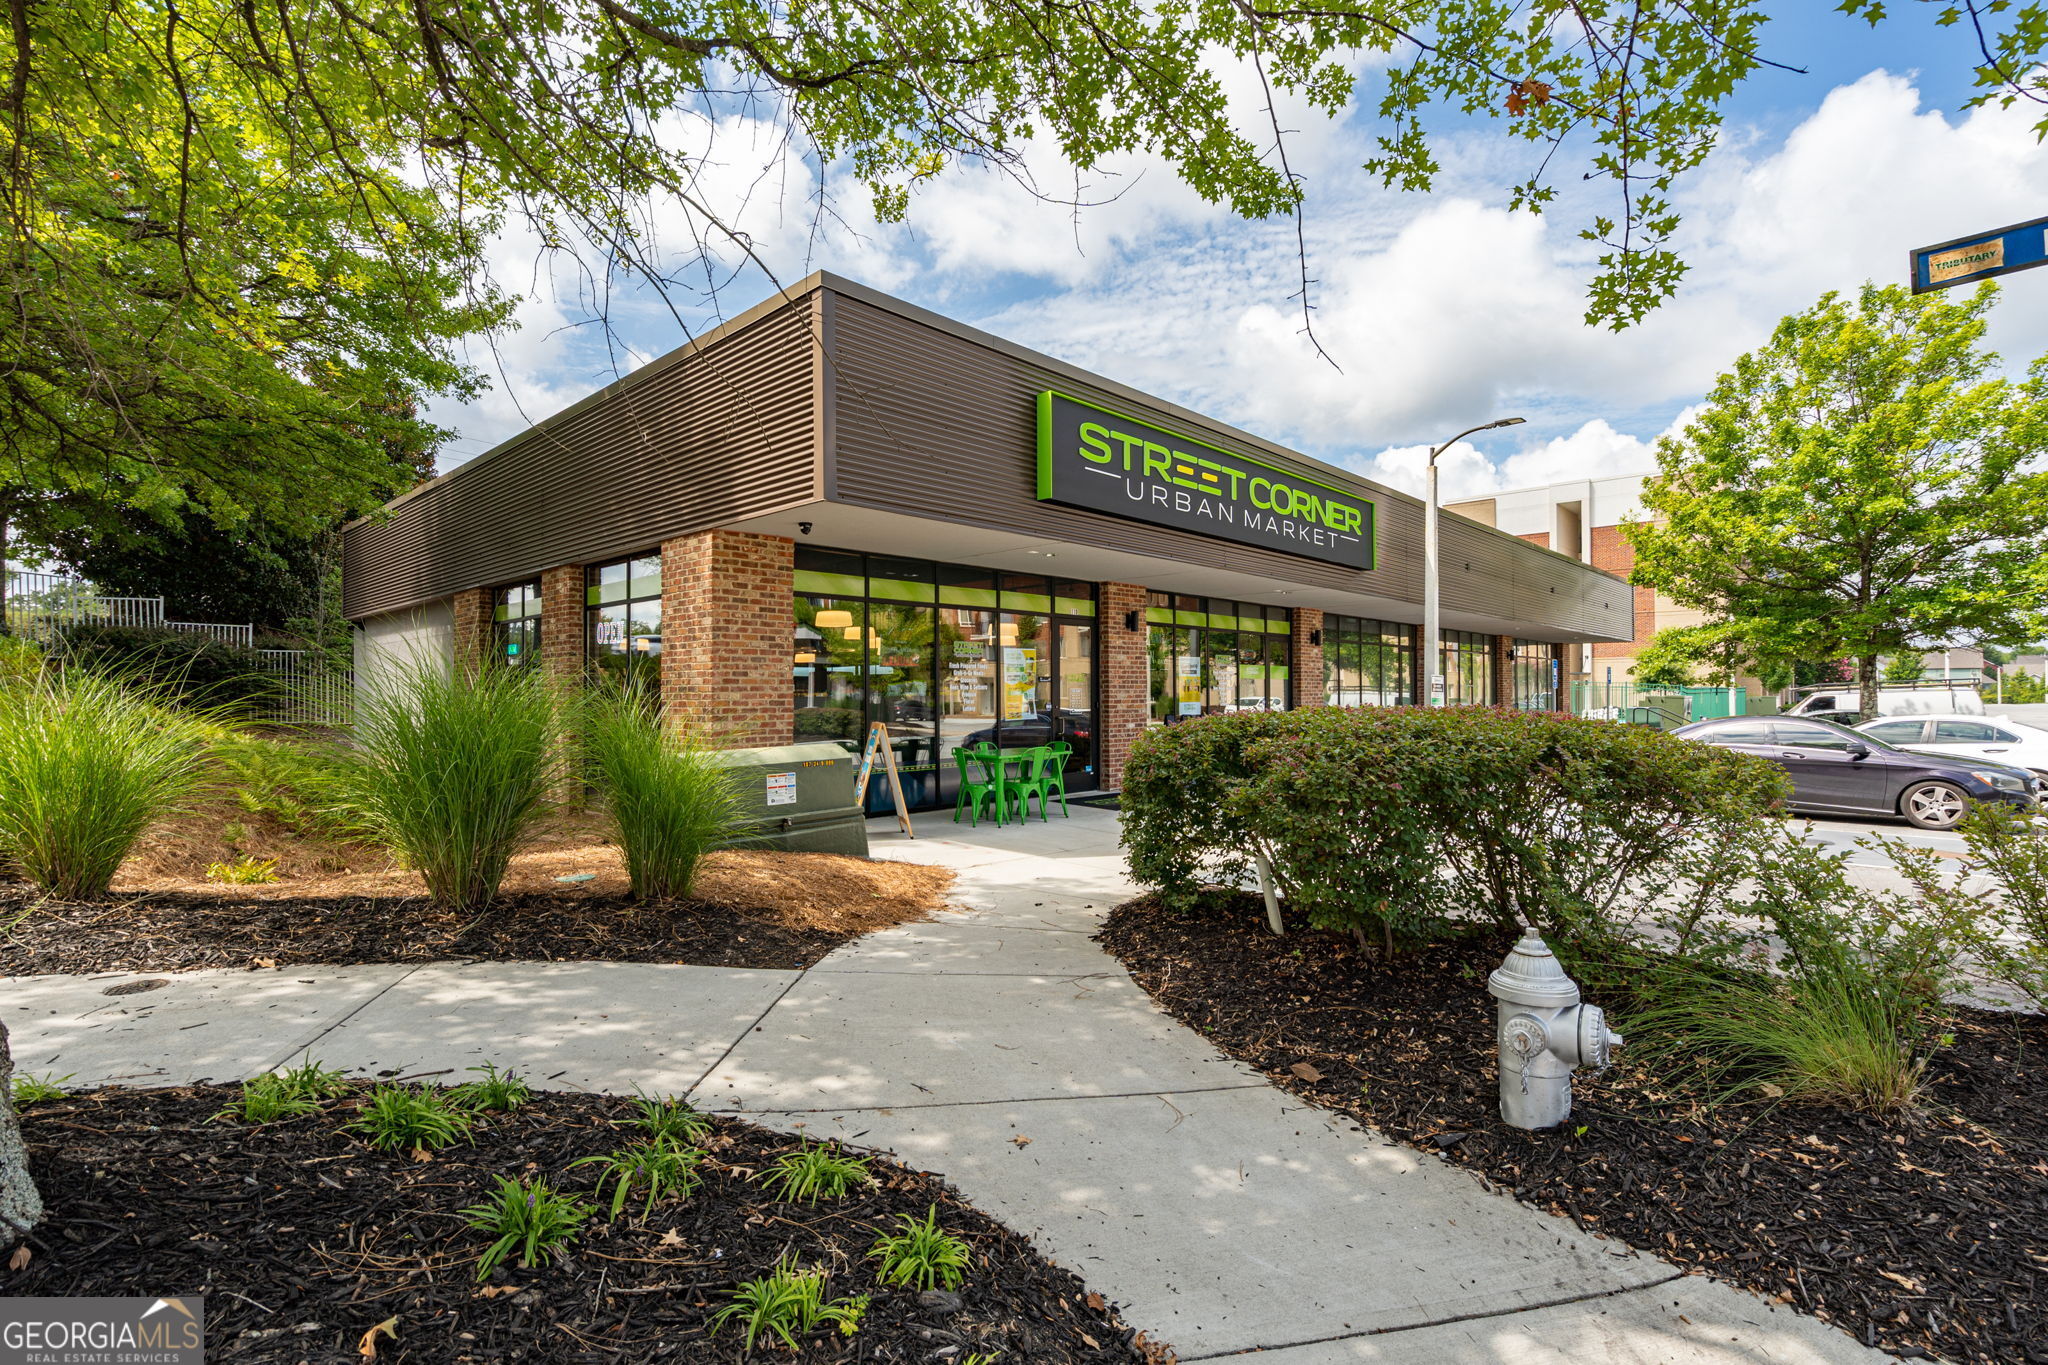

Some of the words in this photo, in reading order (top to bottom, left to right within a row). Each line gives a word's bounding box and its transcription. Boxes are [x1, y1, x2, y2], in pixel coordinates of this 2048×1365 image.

[1935, 250, 1997, 270] TRIBUTARY
[1079, 422, 1246, 500] STREET
[1249, 477, 1363, 535] CORNER
[1126, 478, 1233, 524] URBAN
[1244, 509, 1339, 548] MARKET
[597, 620, 625, 645] OPEN
